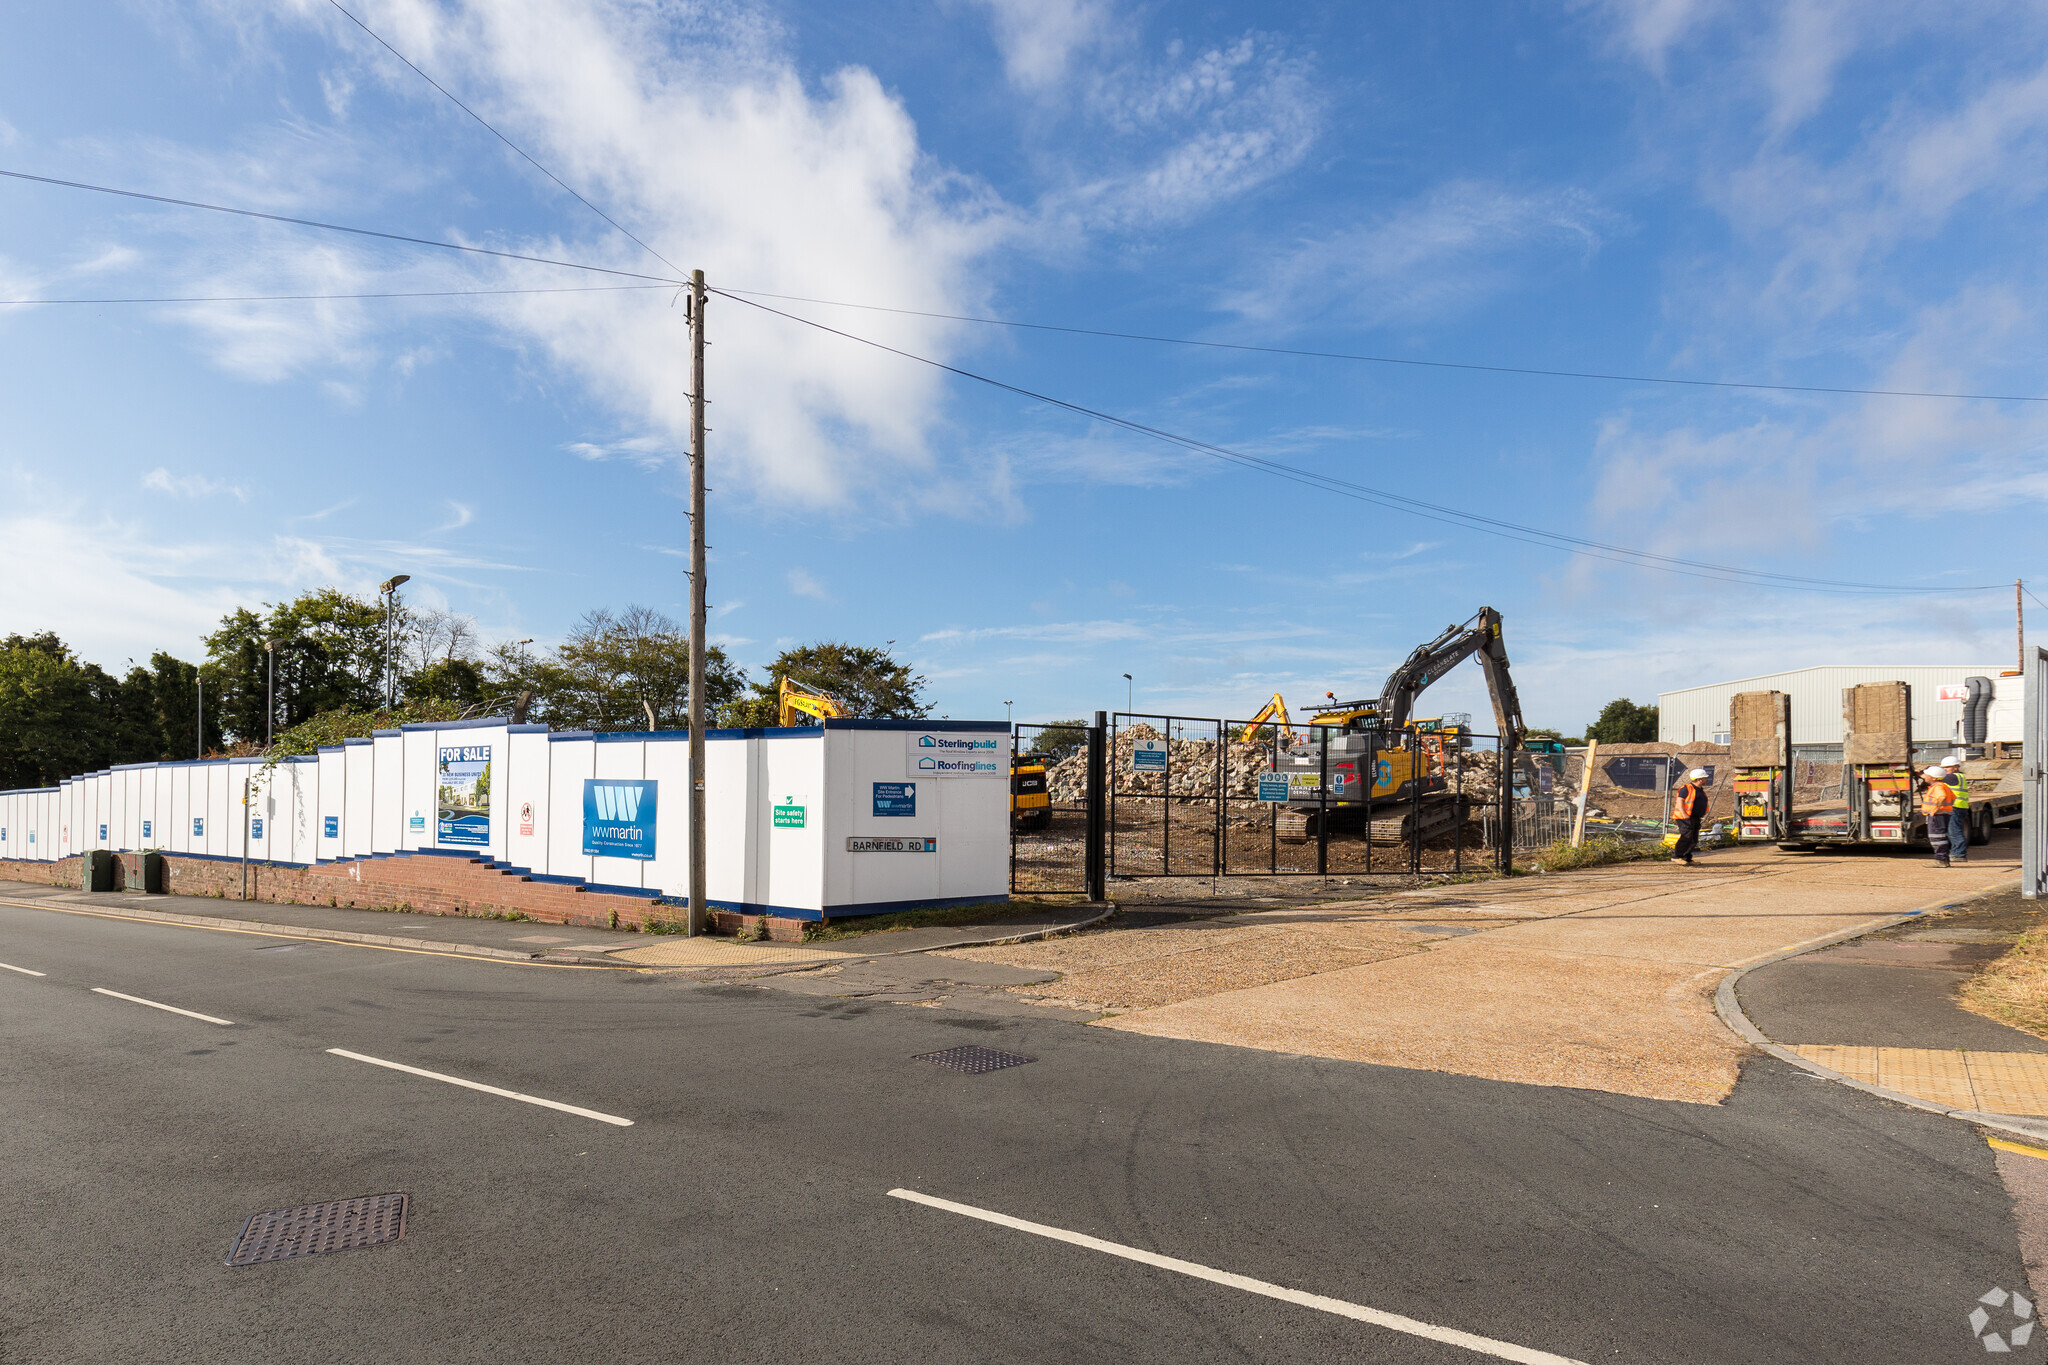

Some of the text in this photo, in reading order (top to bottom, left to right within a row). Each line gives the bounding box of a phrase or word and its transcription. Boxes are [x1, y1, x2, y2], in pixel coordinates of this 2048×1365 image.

[938, 739, 996, 750] Sterlingbuild
[441, 747, 490, 761] FOR SALE
[938, 760, 996, 771] Roofinglines
[592, 825, 642, 840] wwmartin
[853, 842, 921, 850] BARNFIELD RD
